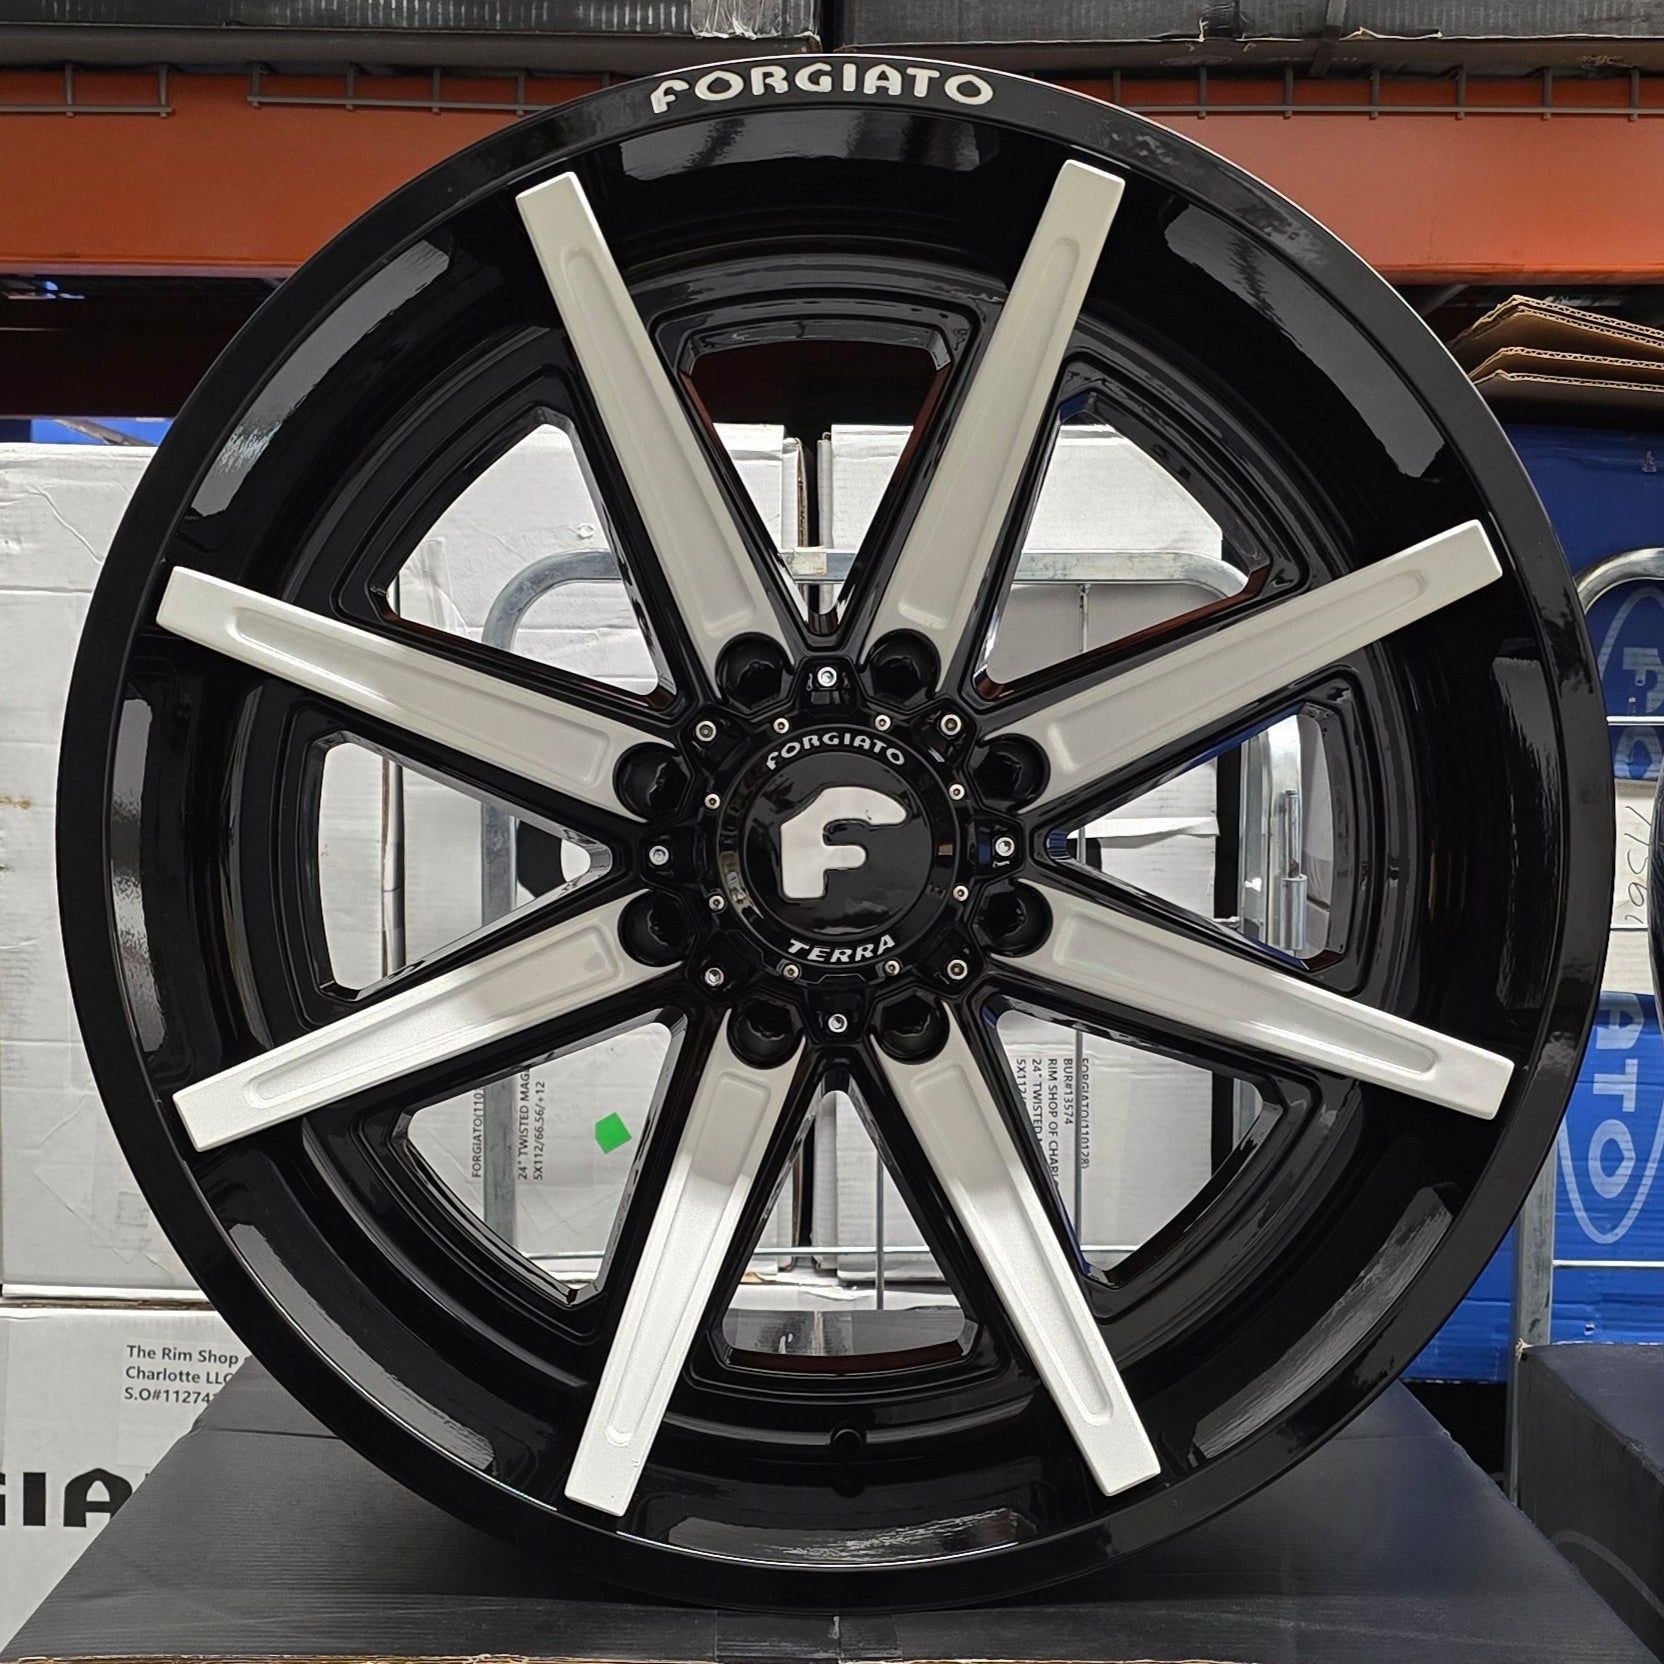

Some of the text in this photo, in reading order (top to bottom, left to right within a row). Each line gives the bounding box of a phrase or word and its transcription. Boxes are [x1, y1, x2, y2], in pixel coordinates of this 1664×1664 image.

[650, 61, 994, 114] FORGIATO
[766, 732, 905, 770] FORGIATO
[780, 786, 907, 899] F
[787, 934, 896, 963] TERRA
[1047, 1058, 1058, 1082] RIM
[1032, 1082, 1043, 1135] TWISTED
[1048, 1084, 1058, 1118] SHOP
[1063, 1058, 1073, 1125] BUR#13574
[518, 1105, 529, 1157] TWISTED
[1048, 1121, 1059, 1139] OF
[125, 1366, 201, 1383] Charlotte
[126, 1345, 239, 1368] The Rim Shop
